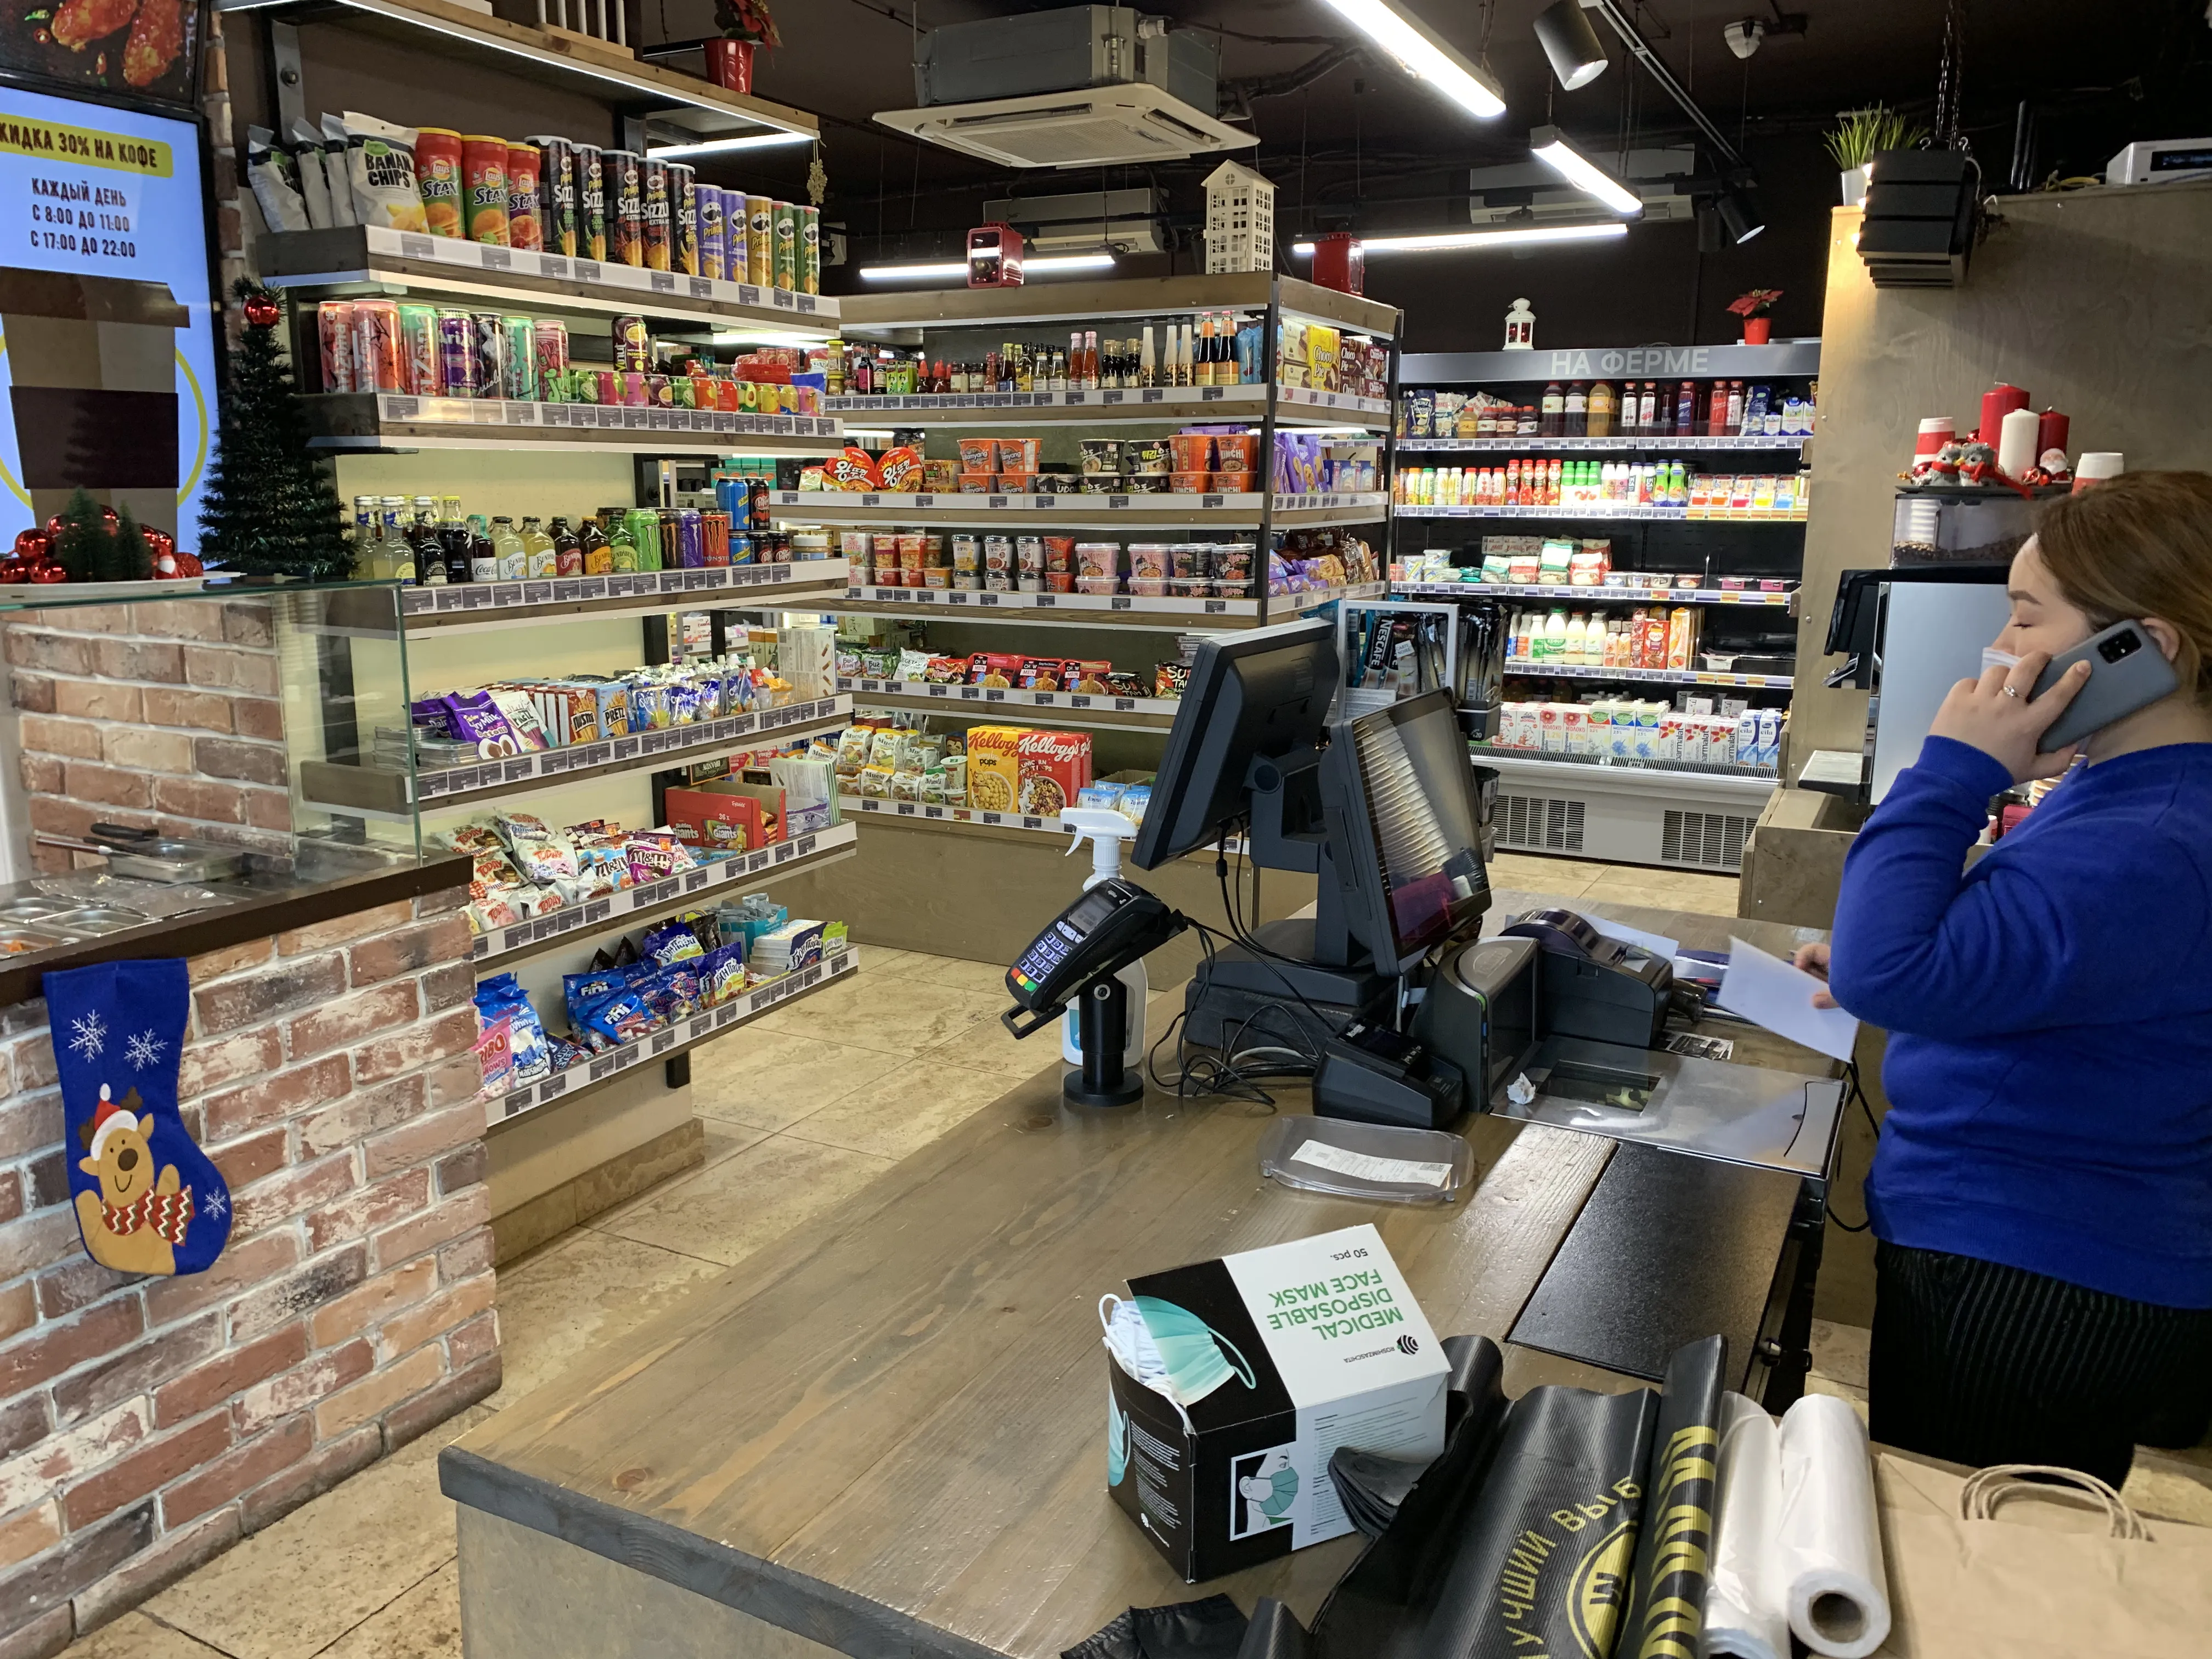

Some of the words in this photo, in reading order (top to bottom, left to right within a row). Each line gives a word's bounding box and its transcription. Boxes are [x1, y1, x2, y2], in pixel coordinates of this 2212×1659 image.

[58, 132, 89, 156] 30%
[94, 138, 114, 161] НА
[119, 142, 157, 168] КОФЕ
[368, 168, 410, 189] CHIPS
[31, 177, 90, 202] КАЖДЫЙ
[94, 187, 126, 207] ДЕНЬ
[32, 204, 41, 221] С
[45, 205, 73, 225] 8:00
[78, 210, 95, 230] ДО
[99, 213, 129, 232] 11:00
[31, 230, 39, 247] С
[43, 232, 76, 251] 17:00
[81, 236, 98, 256] ДО
[102, 238, 136, 258] 22:00
[1313, 345, 1332, 363] Choco
[1341, 347, 1356, 360] Choco
[1551, 352, 1591, 375] НА
[1601, 348, 1709, 374] ФЕРМЕ
[1313, 363, 1324, 378] Pie
[1220, 448, 1244, 459] KIMCHI
[605, 707, 625, 725] PRETZ
[1018, 735, 1080, 763] Kellogg's
[979, 758, 997, 767] pops
[455, 826, 484, 845] TODAY
[713, 828, 737, 840] Giants
[532, 849, 564, 862] TODAY
[476, 859, 503, 878] TODAY
[538, 895, 562, 912] TODAY
[580, 981, 608, 996] Fini
[604, 1003, 631, 1025] Fini
[1330, 1250, 1351, 1261] pcs.
[1353, 1248, 1368, 1259] 50
[1334, 1268, 1384, 1293] FACE
[1267, 1280, 1328, 1308] MASK
[1266, 1287, 1393, 1330] DISPOSABLE
[1312, 1306, 1404, 1341] MEDICAL
[1500, 1528, 1558, 1659] УЧШИЙ
